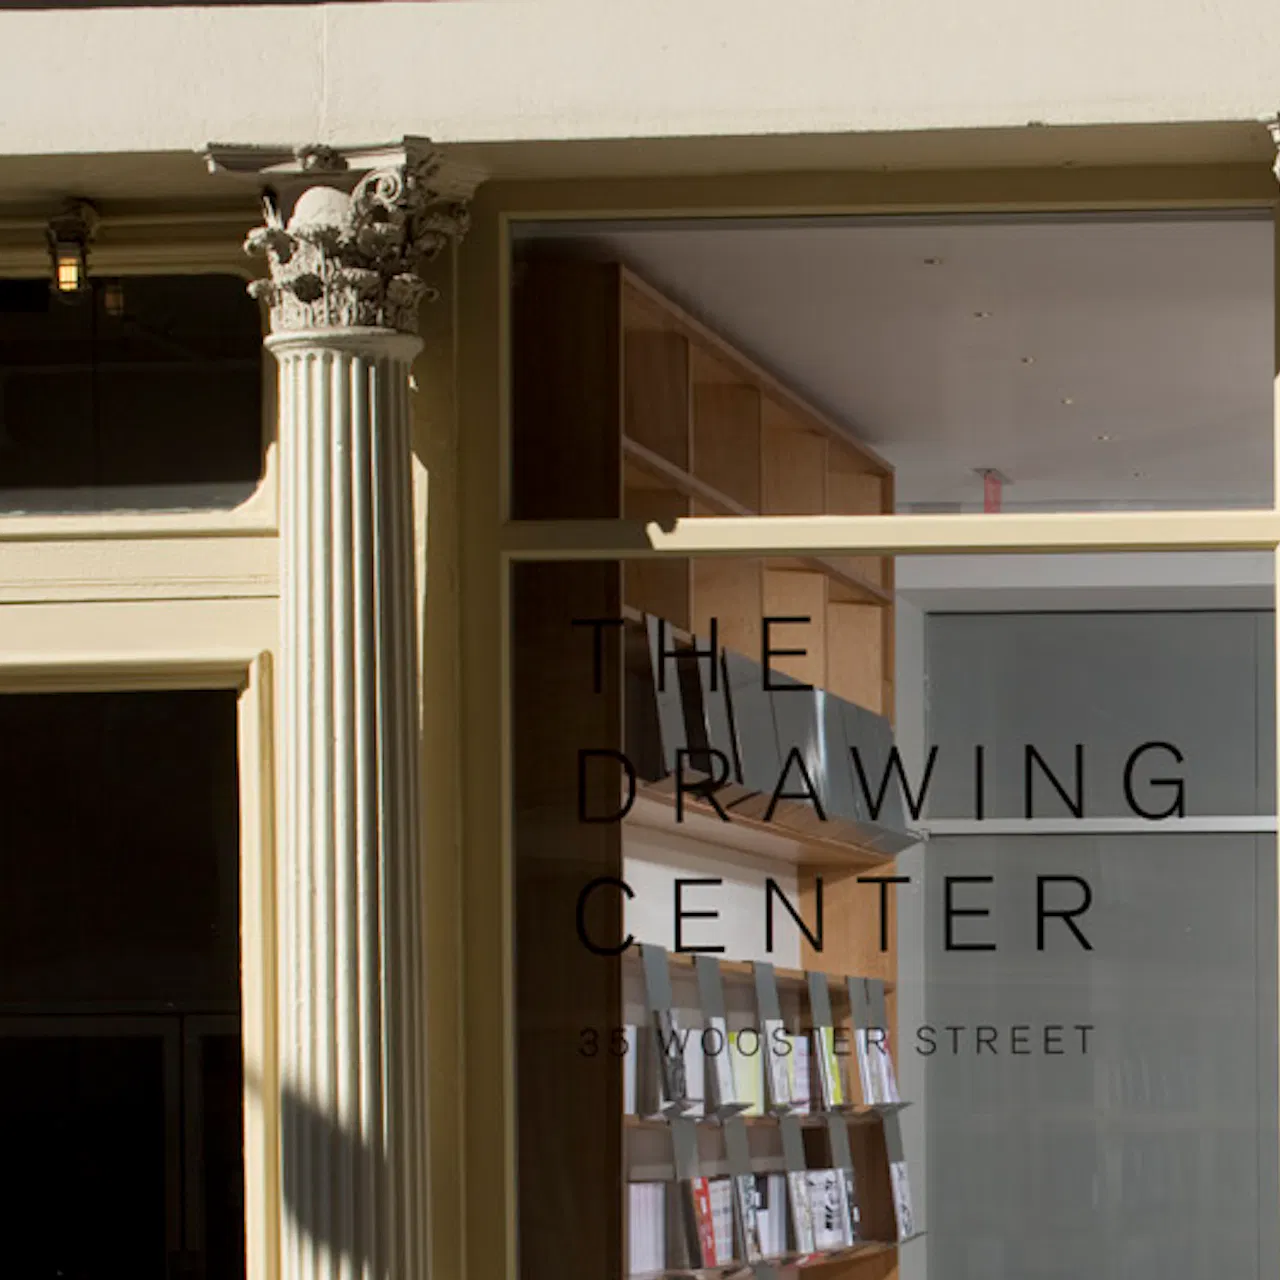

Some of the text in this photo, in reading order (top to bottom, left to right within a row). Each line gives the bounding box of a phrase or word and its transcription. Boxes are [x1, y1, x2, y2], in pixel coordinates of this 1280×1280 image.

[571, 615, 814, 694] THE
[577, 742, 1187, 824] DRAWING
[575, 875, 1095, 957] CENTER
[576, 1025, 1096, 1058] 35 WOOSTER STREET
